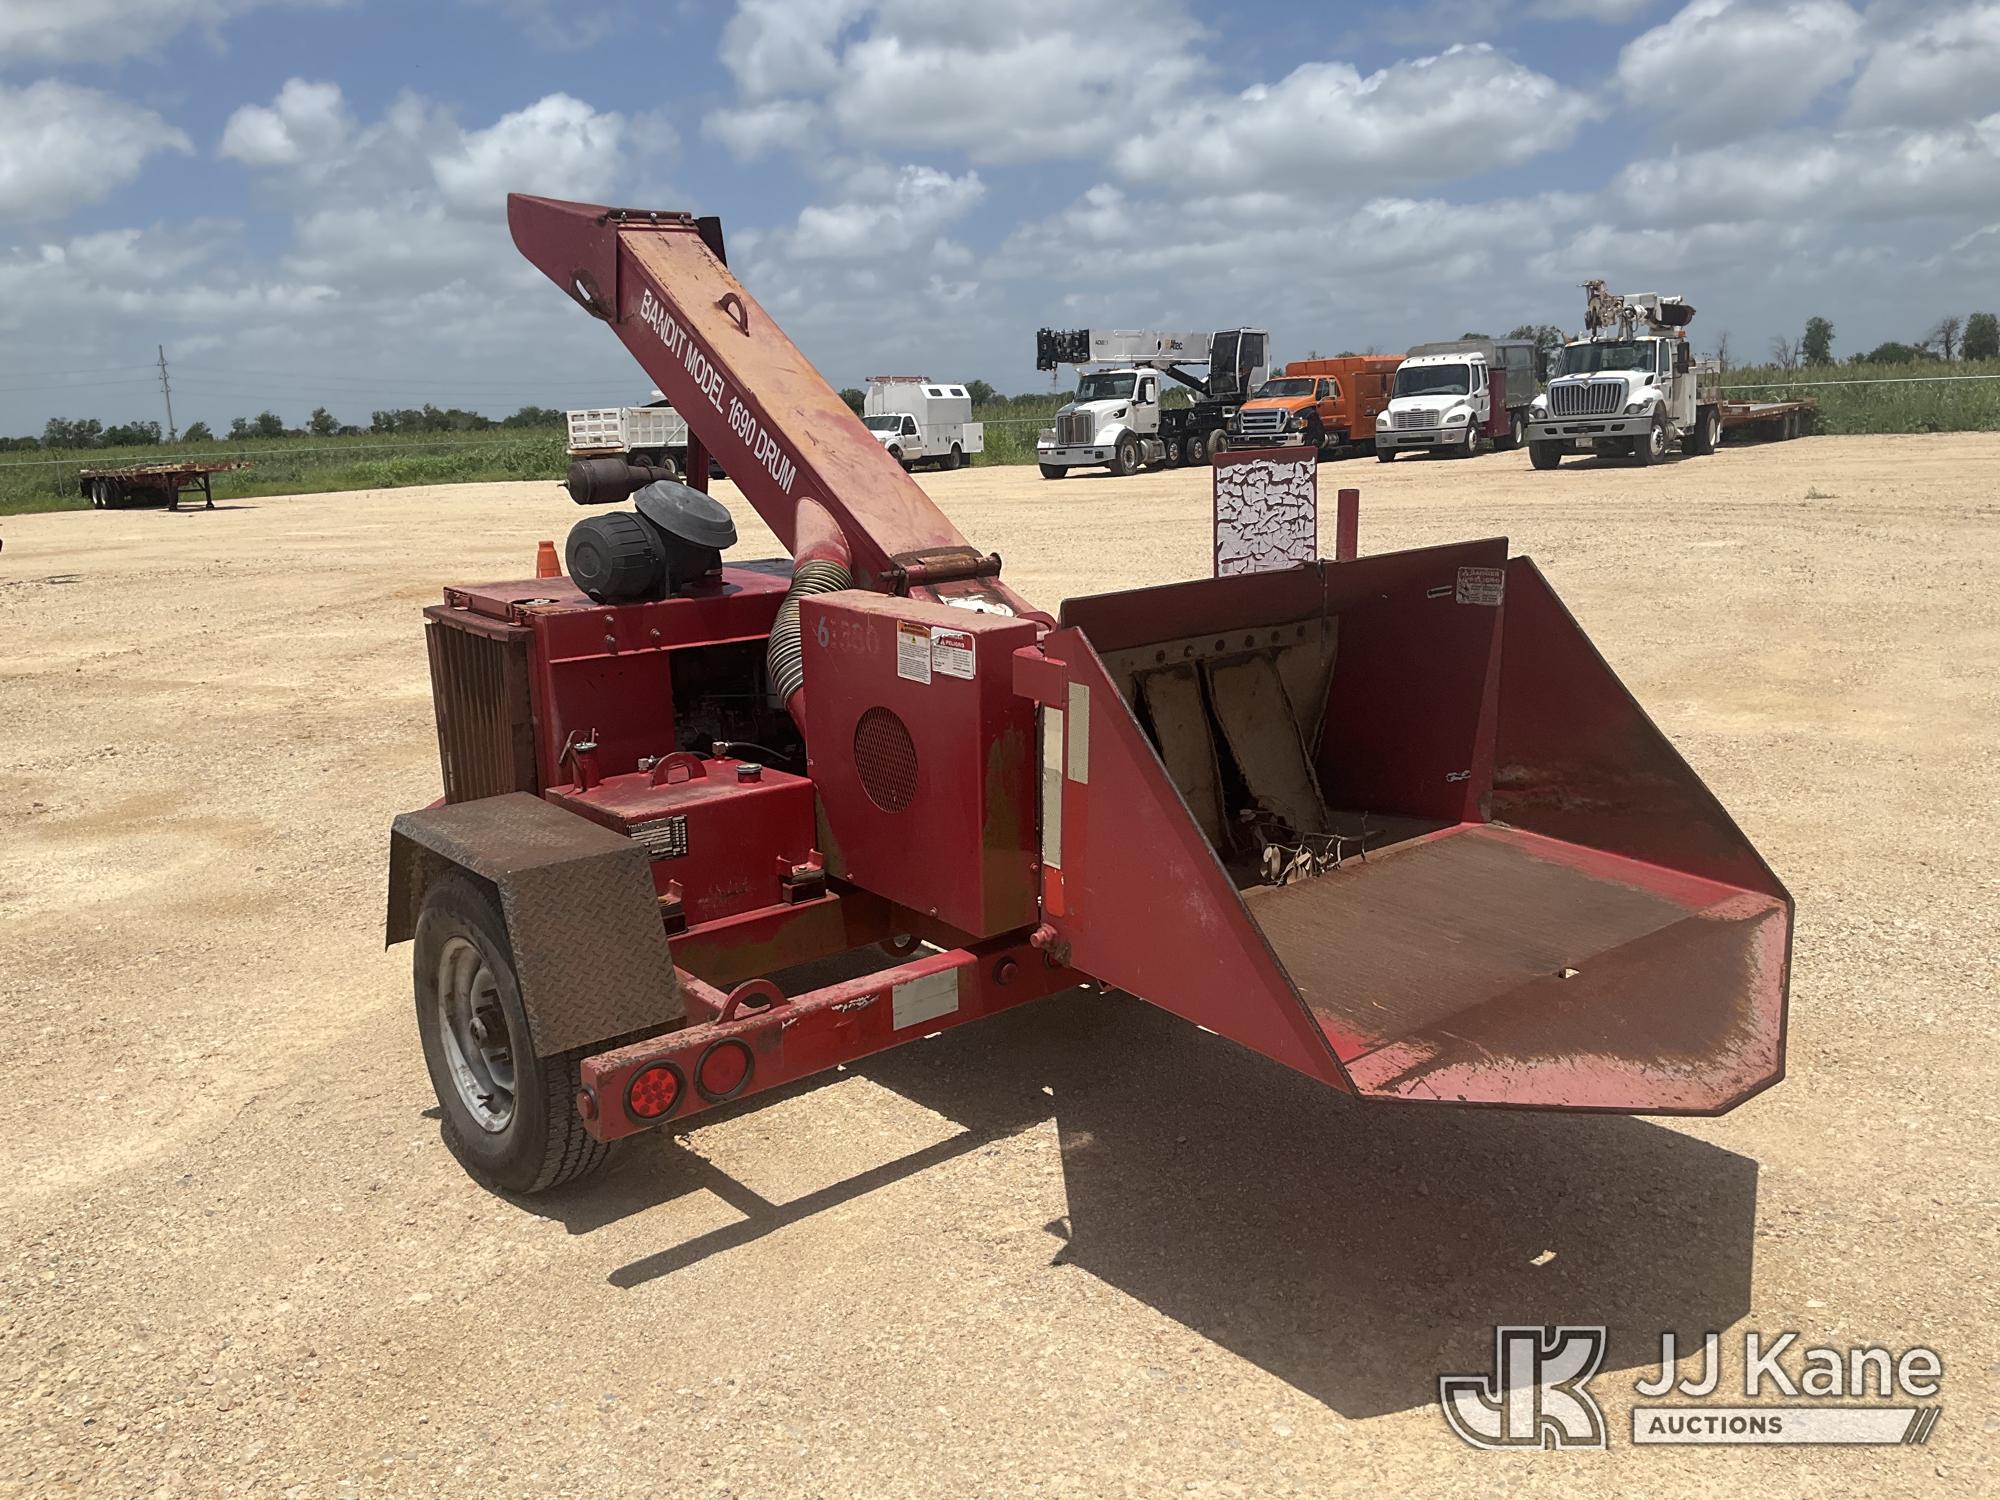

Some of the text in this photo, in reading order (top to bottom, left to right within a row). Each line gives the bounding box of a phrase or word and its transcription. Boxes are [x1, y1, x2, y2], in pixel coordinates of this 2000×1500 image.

[640, 288, 797, 494] BANDIT MODEL 1690 DRUM
